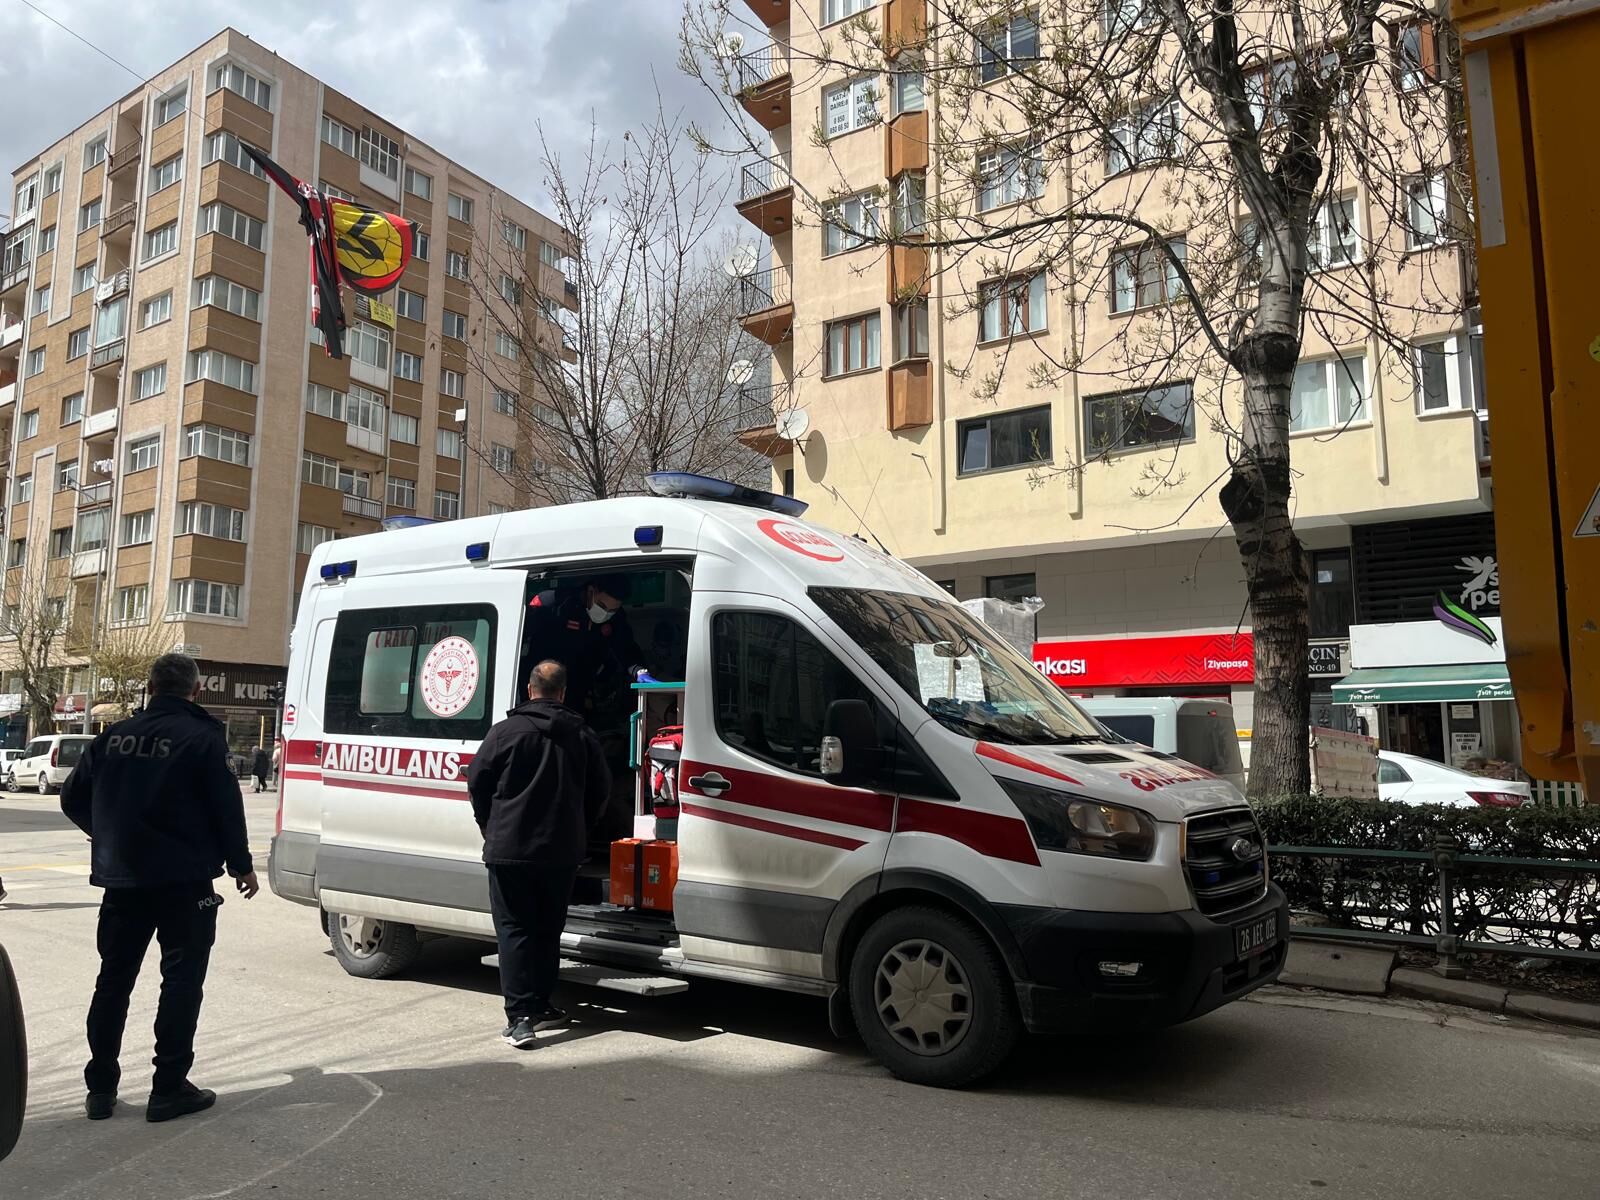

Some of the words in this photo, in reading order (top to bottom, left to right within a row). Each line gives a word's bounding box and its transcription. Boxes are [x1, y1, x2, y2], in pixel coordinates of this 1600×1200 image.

[1471, 589, 1500, 611] pe
[1034, 656, 1086, 675] nkası
[1207, 659, 1249, 670] Ziyapaşa
[1308, 647, 1340, 664] ÇIN.
[200, 672, 226, 693] ZGİ
[234, 683, 277, 701] KUR
[323, 743, 461, 780] AMBULANS
[1241, 928, 1250, 952] 26
[1252, 923, 1263, 946] AEC
